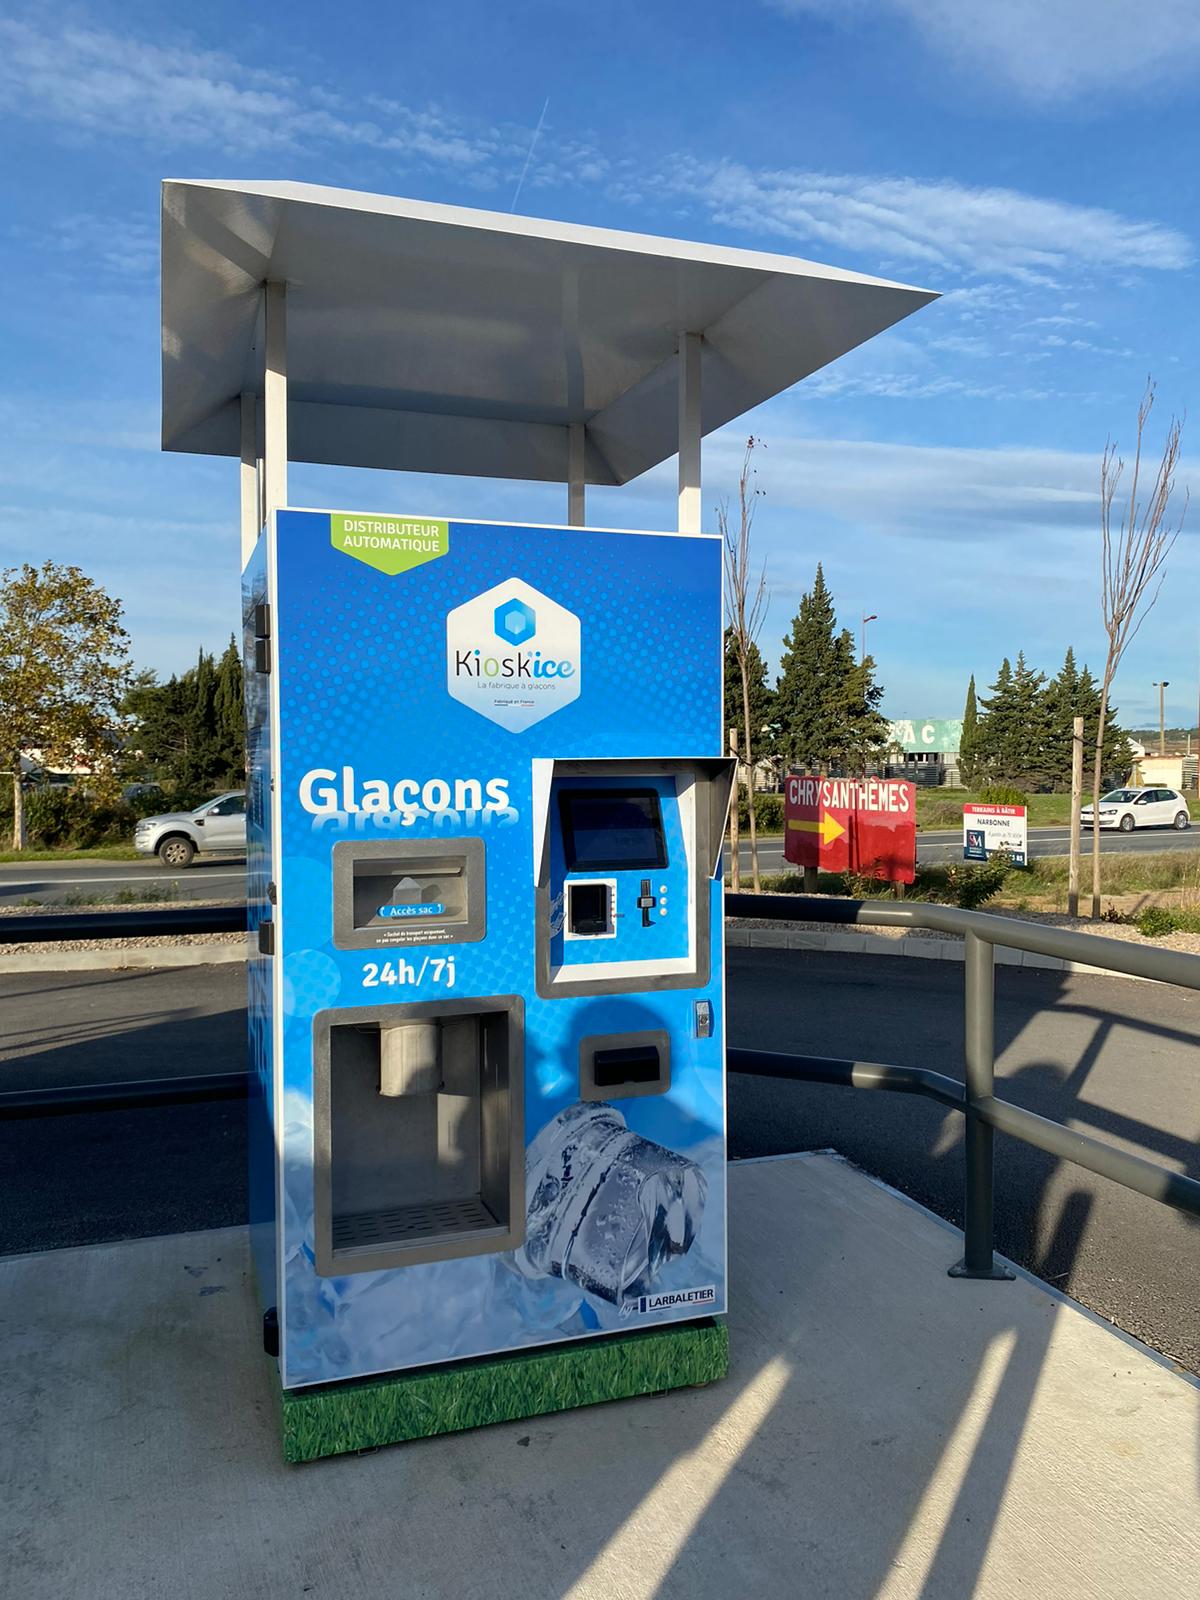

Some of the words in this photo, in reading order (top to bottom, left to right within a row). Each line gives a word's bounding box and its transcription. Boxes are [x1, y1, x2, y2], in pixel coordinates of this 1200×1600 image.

[344, 519, 440, 537] DISTRIBUTEUR
[343, 535, 440, 552] AUTOMATIQUE
[477, 681, 487, 689] La
[488, 681, 520, 691] fabrique
[299, 766, 510, 826] Glaçons
[789, 777, 909, 813] CHRYSANTHÈMES
[977, 818, 1010, 827] NARBONNE
[389, 905, 417, 916] Accès
[418, 906, 433, 914] sac
[362, 956, 456, 987] 24h/7j
[649, 1289, 714, 1308] LARBALETIER
